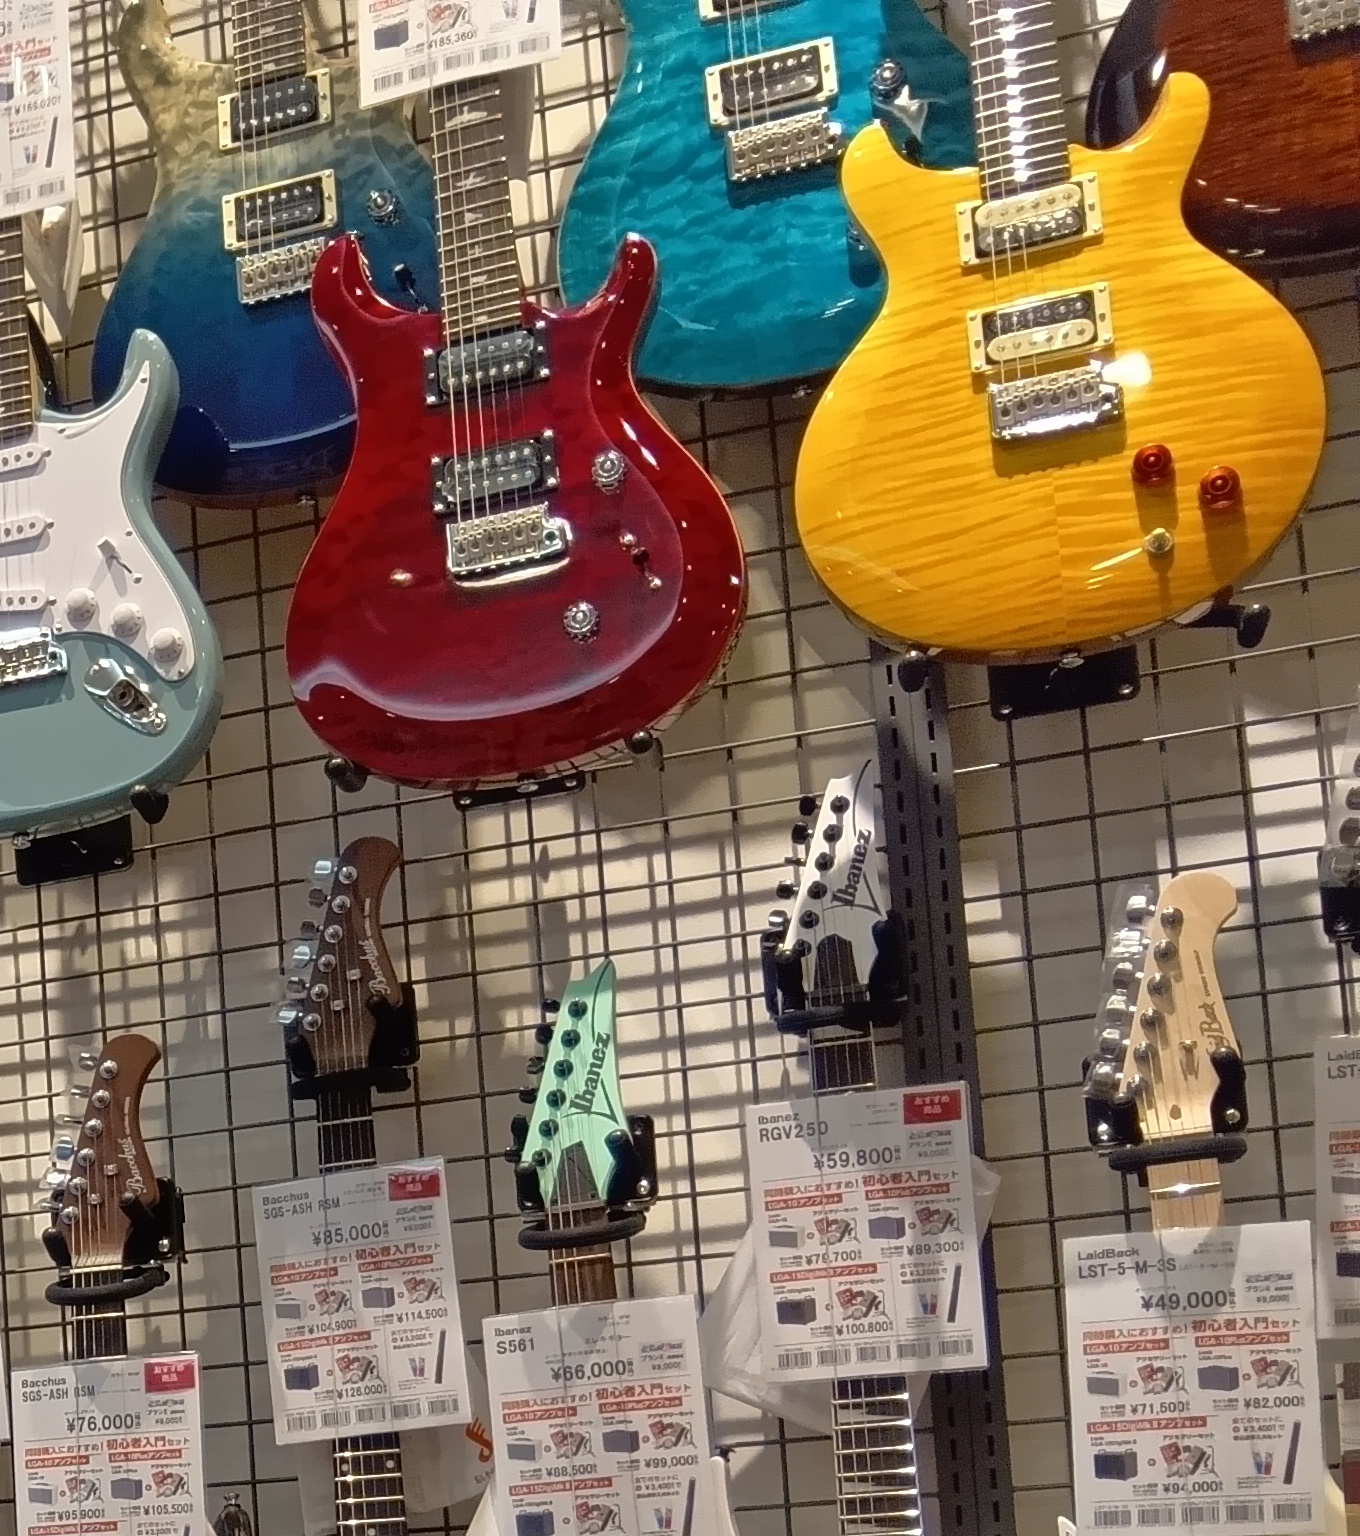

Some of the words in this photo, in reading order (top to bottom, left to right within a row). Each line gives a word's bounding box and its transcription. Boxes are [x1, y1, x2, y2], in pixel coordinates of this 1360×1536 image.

[830, 829, 871, 907] Ibanez
[359, 937, 390, 995] Bacchus
[569, 1032, 610, 1113] Ibanez
[758, 1113, 800, 1123] Ibanez
[759, 1121, 829, 1142] RGV250
[813, 1148, 893, 1169] ¥59,800
[262, 1192, 309, 1206] Bacchus
[312, 1222, 382, 1246] ¥85,000
[1078, 1248, 1139, 1261] LaidBack
[1078, 1259, 1176, 1279] LST-5-M-3S
[1140, 1289, 1227, 1311] ¥49,000
[494, 1326, 532, 1337] Ibanez
[836, 1321, 889, 1335] ¥100,800
[1192, 1316, 1300, 1332] 初心者入門セット
[497, 1338, 534, 1353] S561
[551, 1360, 626, 1382] ¥66,000
[21, 1377, 66, 1388] Bacchus
[22, 1388, 69, 1402] SGS-ASH
[1243, 1396, 1300, 1409] ¥82,000
[66, 1414, 135, 1433] ¥76,000
[644, 1455, 695, 1469] ¥99,000
